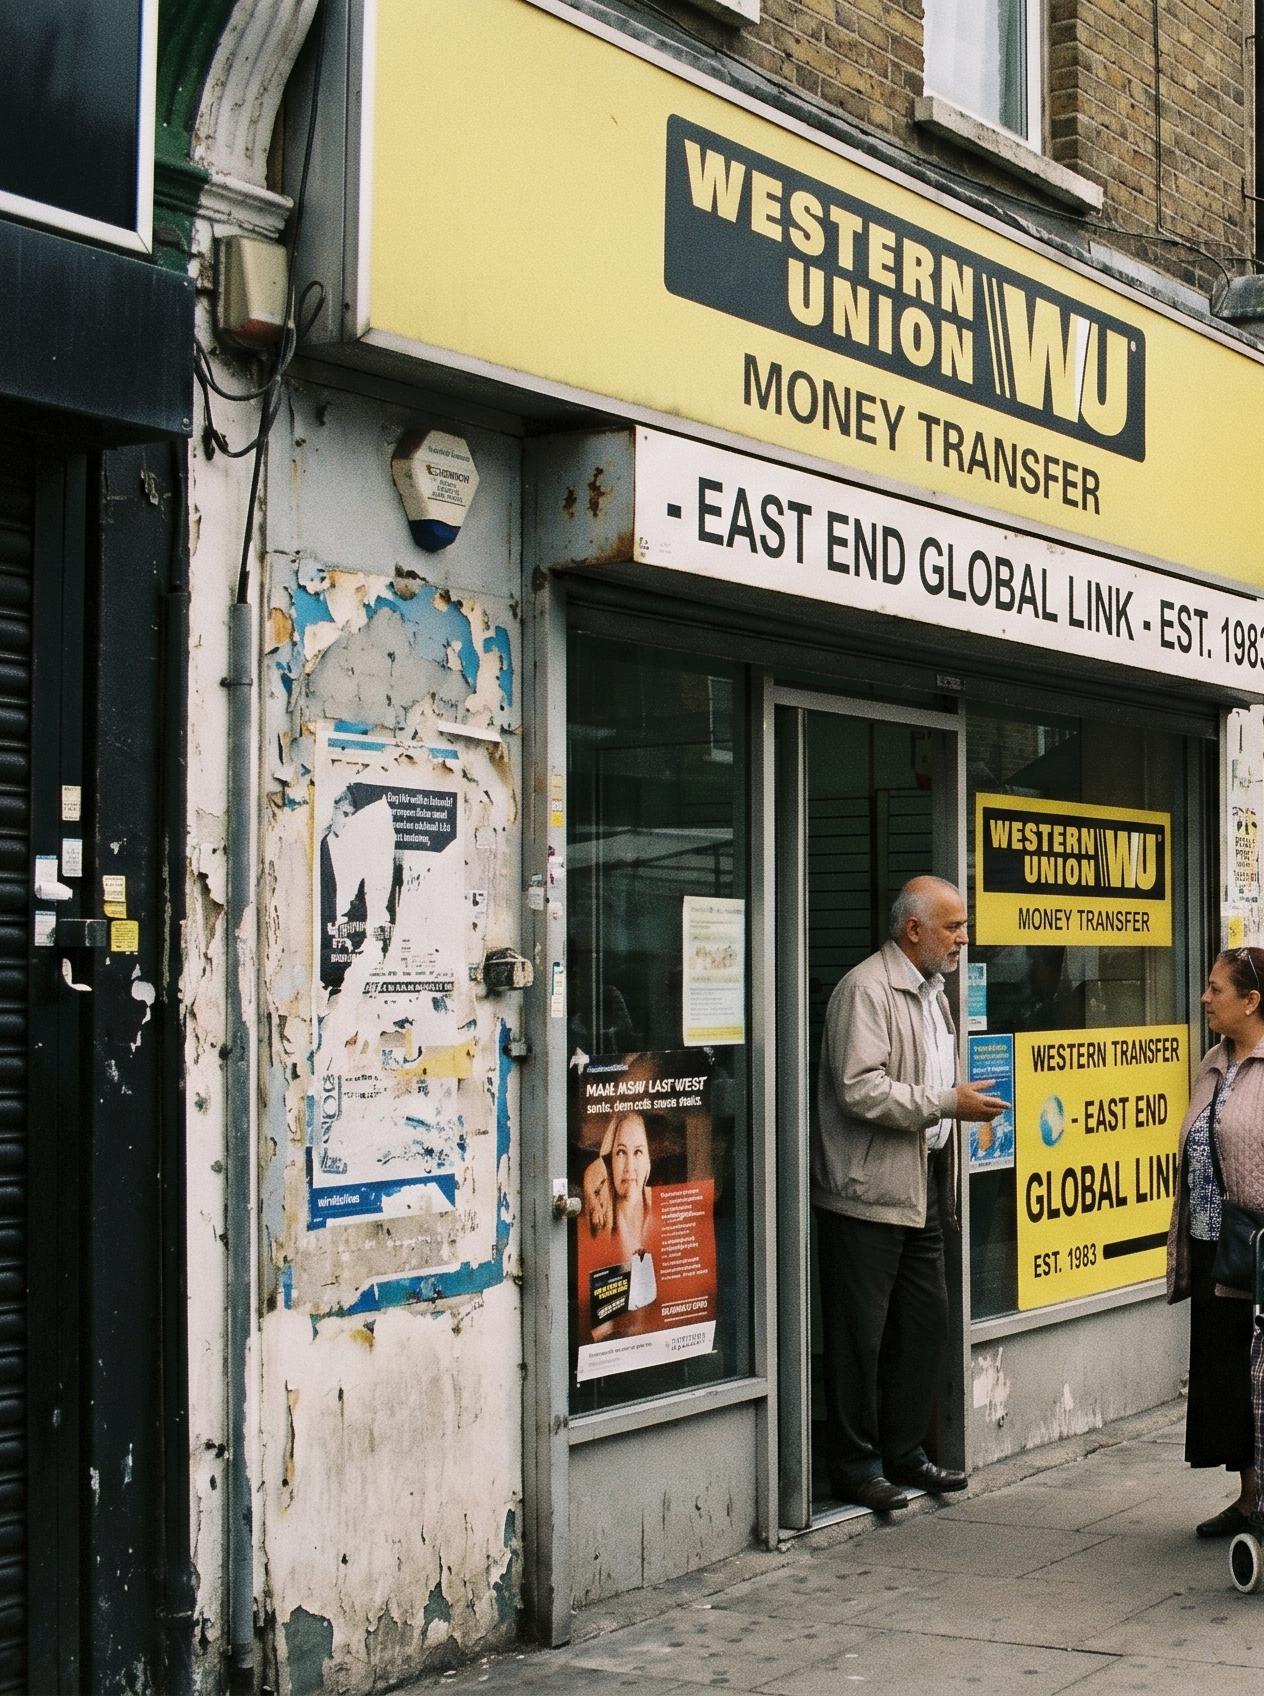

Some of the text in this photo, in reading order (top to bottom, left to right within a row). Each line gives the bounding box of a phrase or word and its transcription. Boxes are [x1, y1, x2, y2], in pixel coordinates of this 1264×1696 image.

[684, 138, 975, 321] WESTERN
[787, 258, 974, 385] UNION
[1001, 281, 1129, 437] WU
[743, 353, 1101, 515] MONEY TRANSFER
[698, 476, 812, 565] EAST
[827, 510, 906, 585] END
[918, 536, 1058, 624] GLOBAL
[1068, 574, 1136, 642] LINK
[1159, 599, 1214, 659] EST.
[989, 819, 1095, 856] WESTERN
[1106, 829, 1157, 891] WU
[1024, 856, 1095, 887] UNION
[1018, 907, 1150, 933] MONEY TRANSFER
[1031, 1041, 1106, 1073] WESTERN
[1111, 1037, 1180, 1066] TRANSFER
[1084, 1096, 1129, 1135] EAST
[1135, 1092, 1168, 1128] END
[1025, 1160, 1128, 1224] GLOBAL
[1033, 1243, 1097, 1279] EST. 1983
